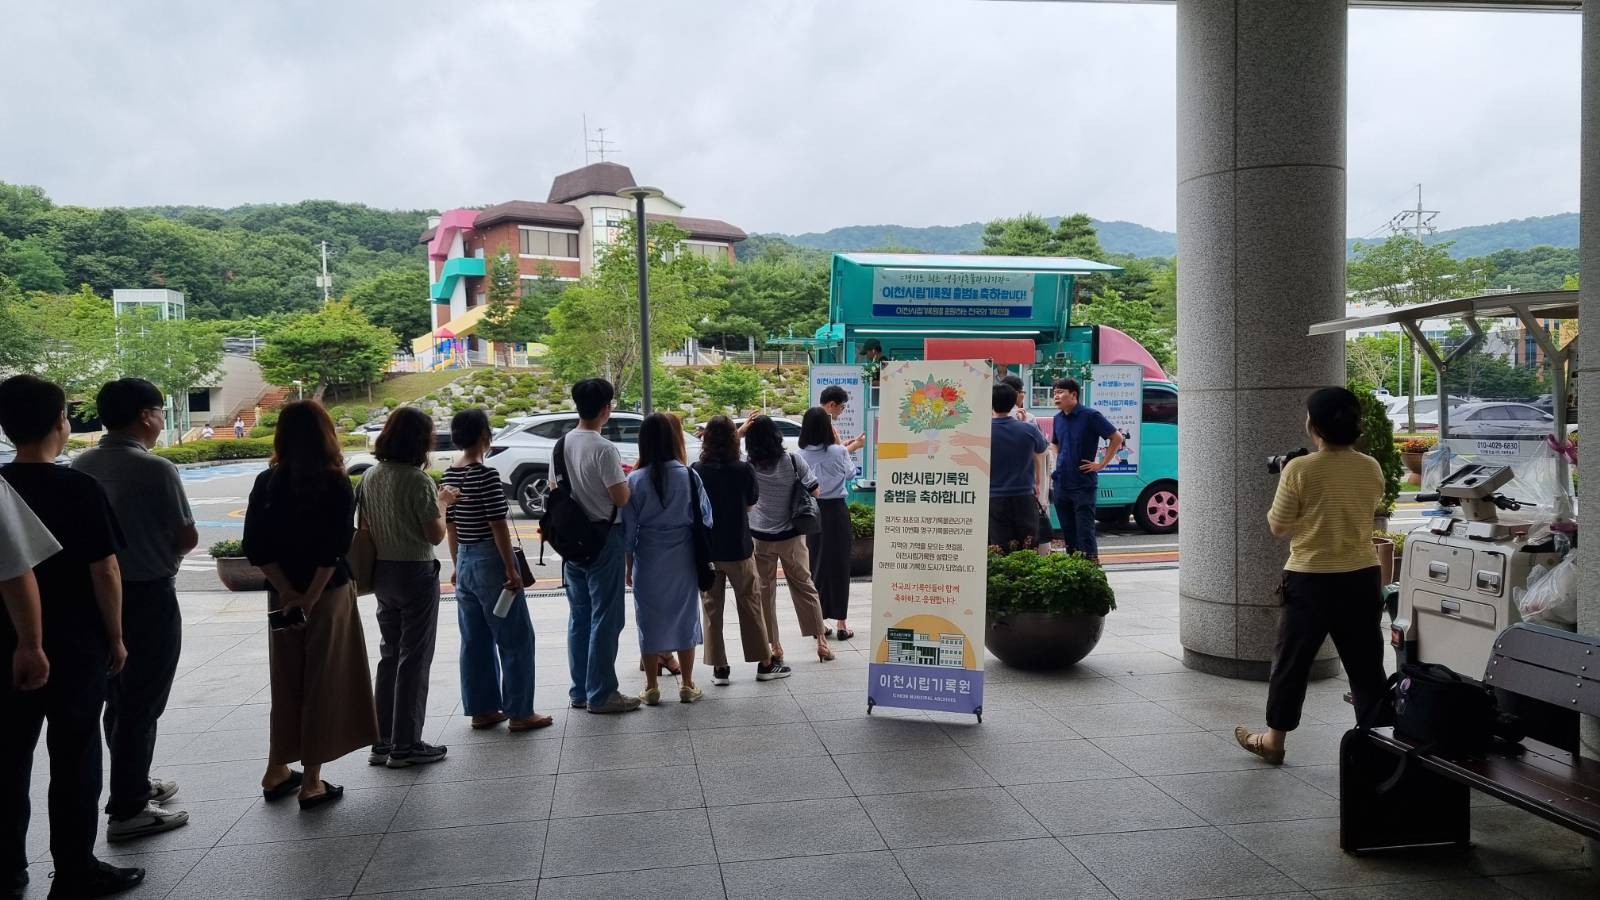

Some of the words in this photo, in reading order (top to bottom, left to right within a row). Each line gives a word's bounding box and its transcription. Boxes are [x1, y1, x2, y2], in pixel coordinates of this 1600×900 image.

[882, 286, 951, 300] 이천시립기록원
[953, 287, 979, 300] 출범을
[980, 288, 1027, 301] 축하합니다!
[891, 472, 969, 486] 이천시립기록원
[884, 490, 917, 504] 출범을
[920, 490, 977, 505] 축하합니다
[903, 516, 920, 524] 최초의
[884, 526, 901, 534] 전국의
[895, 553, 935, 561] 이천시립기록원
[890, 582, 911, 591] 전국의
[945, 584, 960, 593] 함께
[880, 674, 971, 694] 이천시립기록원
